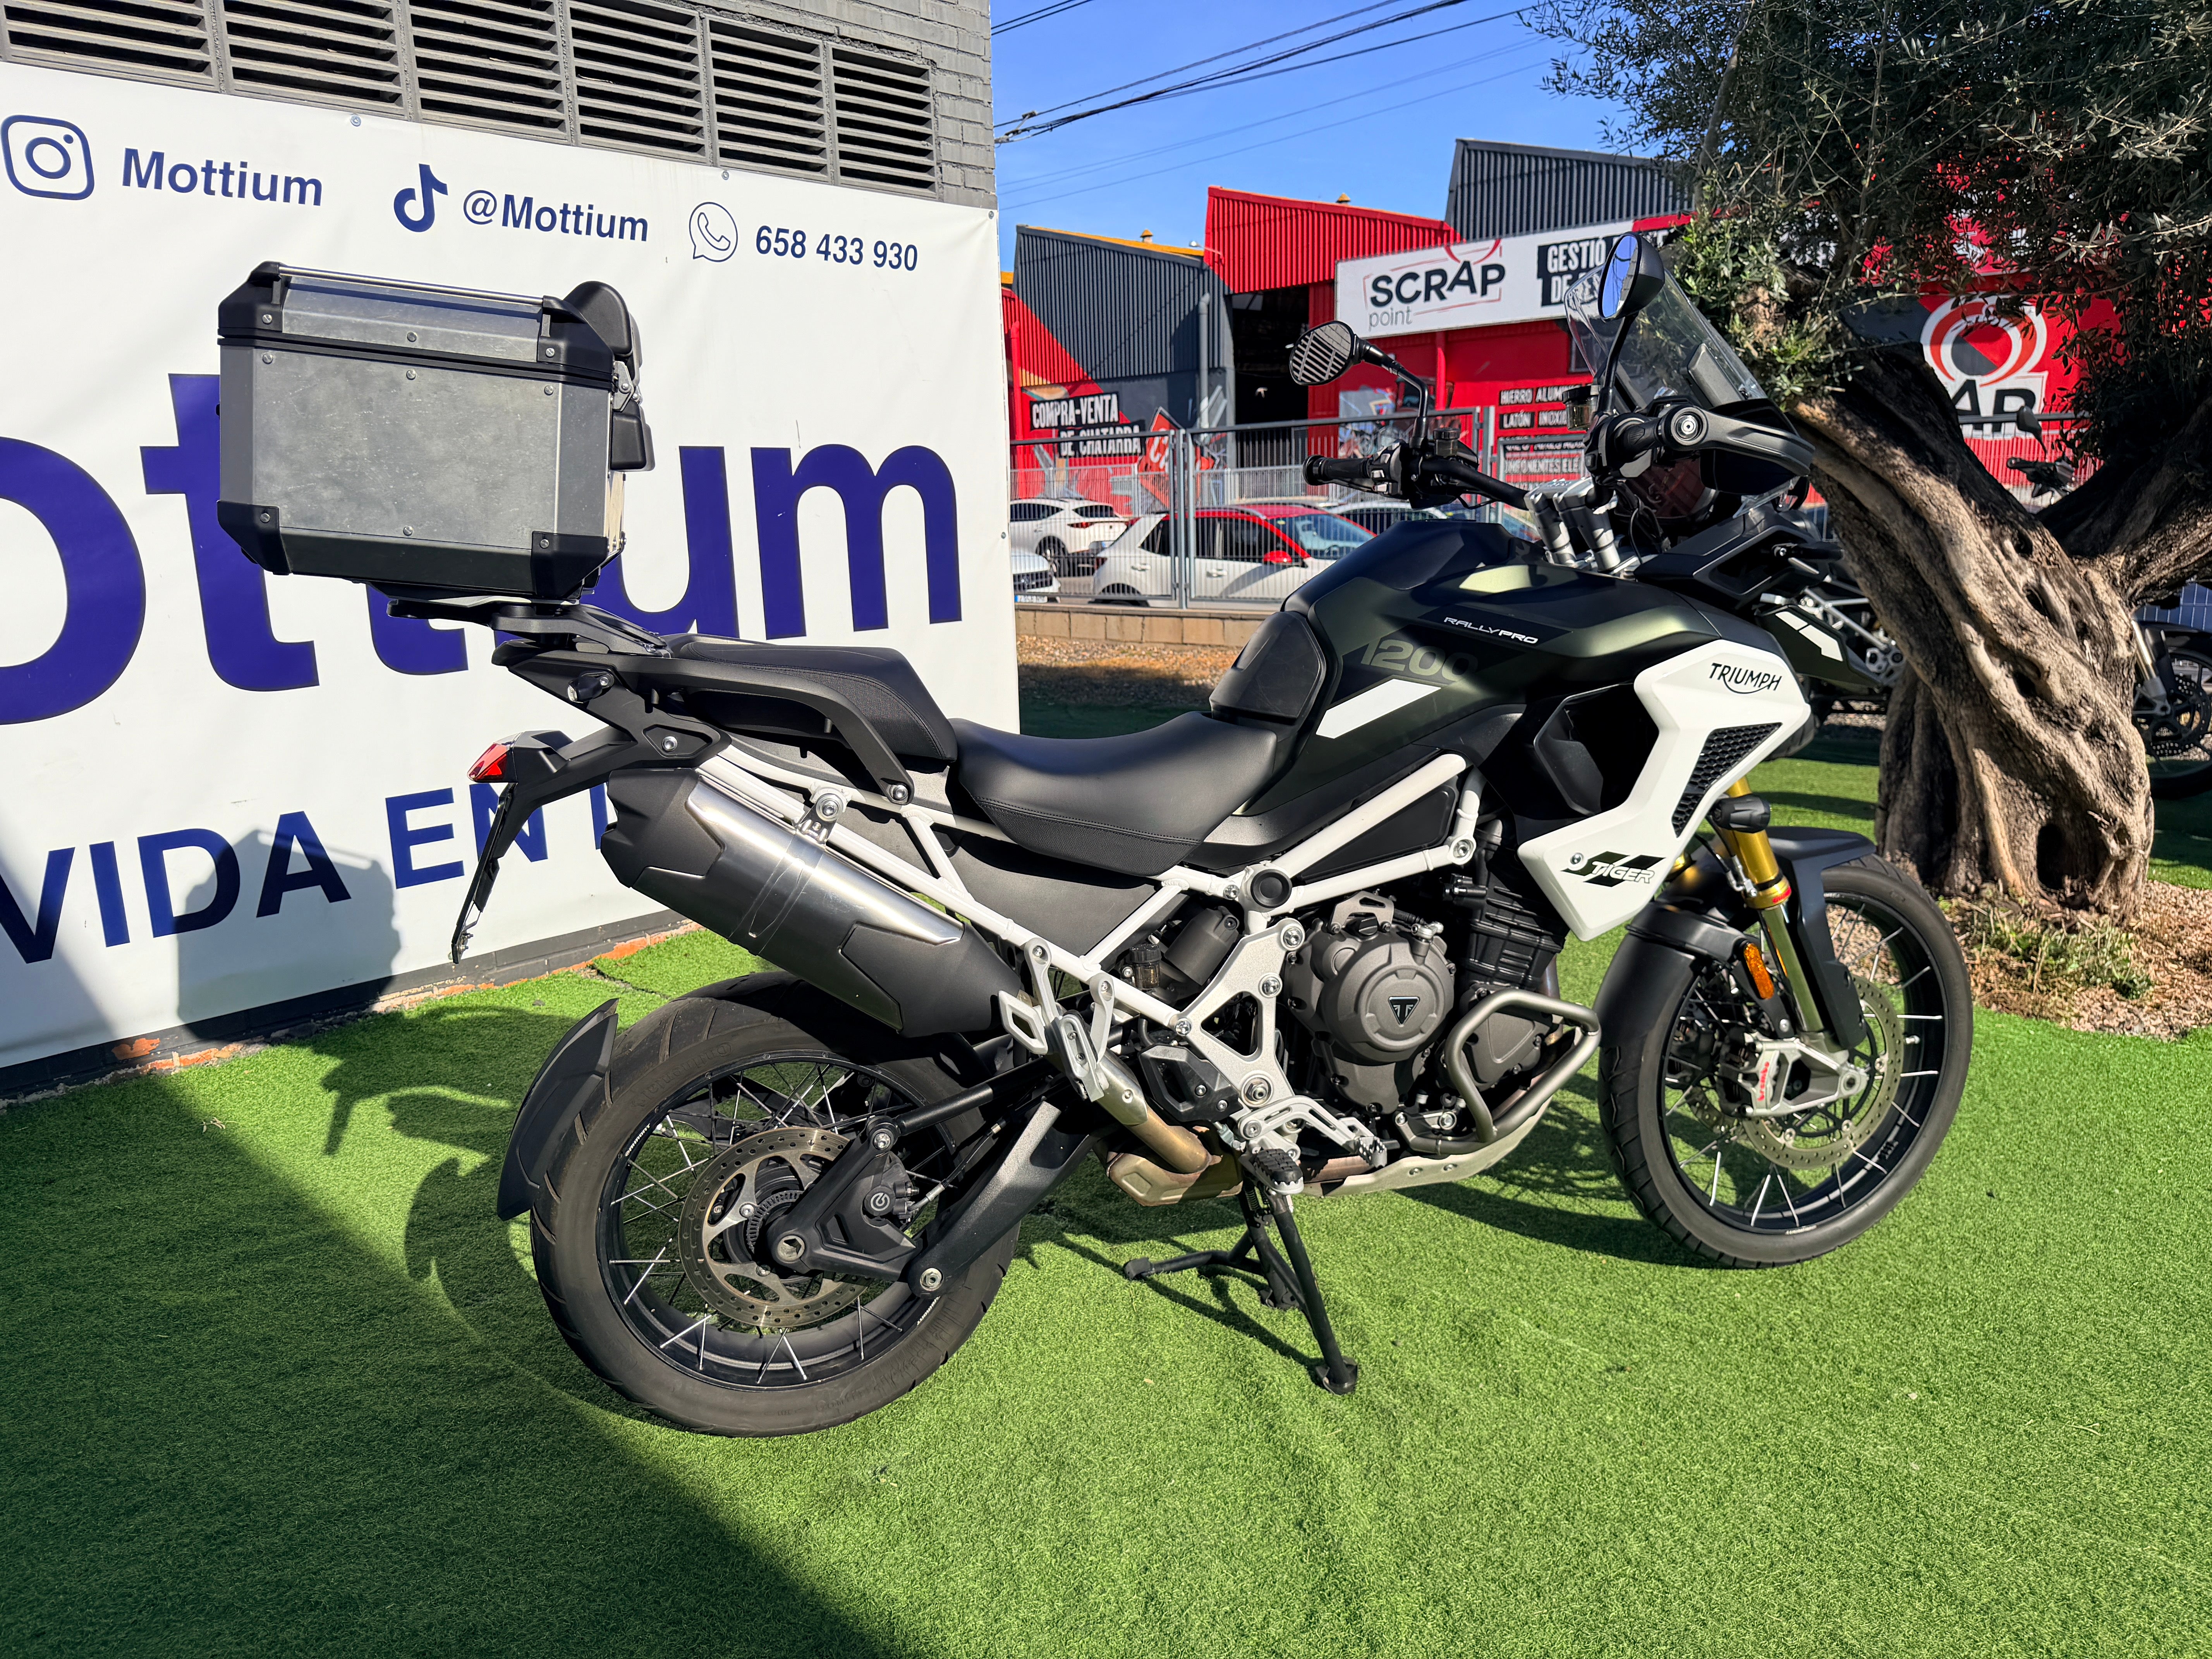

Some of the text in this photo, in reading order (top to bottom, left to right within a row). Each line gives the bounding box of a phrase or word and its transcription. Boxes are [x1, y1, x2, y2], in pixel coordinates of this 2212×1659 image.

[122, 148, 322, 206] Mottium
[464, 190, 648, 241] @Mottium
[756, 225, 918, 271] 658 433 930
[1371, 261, 1506, 307] SCRAP
[1369, 306, 1413, 332] point
[1032, 393, 1119, 428] COMPRA-VENTA
[1501, 388, 1533, 405] HIERRO
[1060, 430, 1075, 456] DE
[1079, 424, 1142, 455] CHATARRA
[1361, 639, 1479, 681] 1200
[1709, 663, 1783, 694] TRIUMPH
[0, 811, 352, 964] VIDA
[386, 783, 548, 889] EN
[1592, 861, 1655, 884] TIGER
